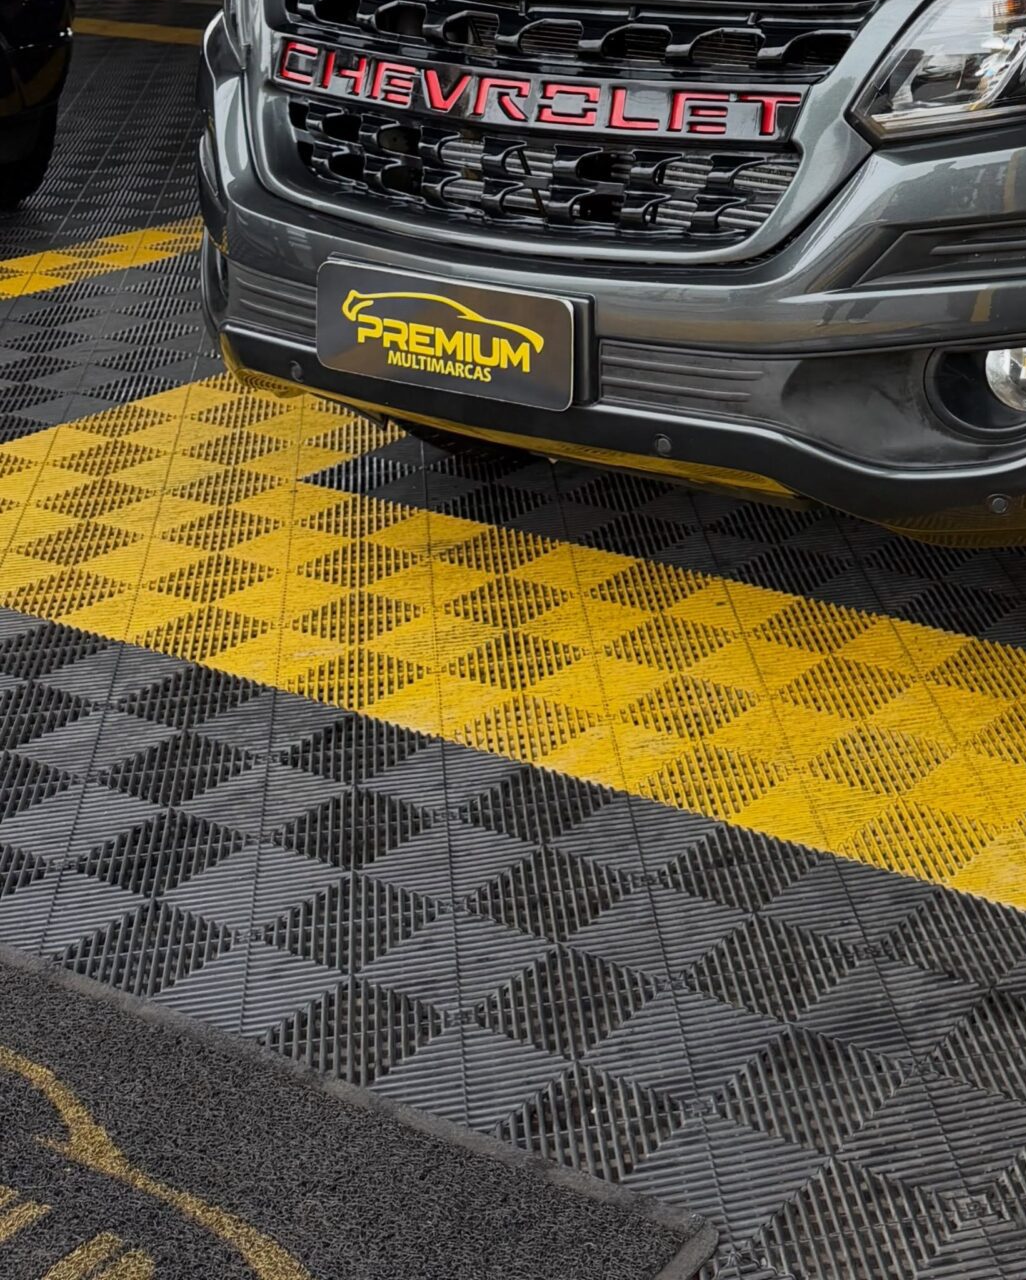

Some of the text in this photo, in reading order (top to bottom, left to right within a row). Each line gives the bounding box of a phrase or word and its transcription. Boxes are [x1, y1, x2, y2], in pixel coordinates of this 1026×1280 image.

[280, 41, 801, 137] CHEVROLET
[357, 314, 531, 373] PREMIUM
[387, 351, 492, 382] MULTIMARCAS
